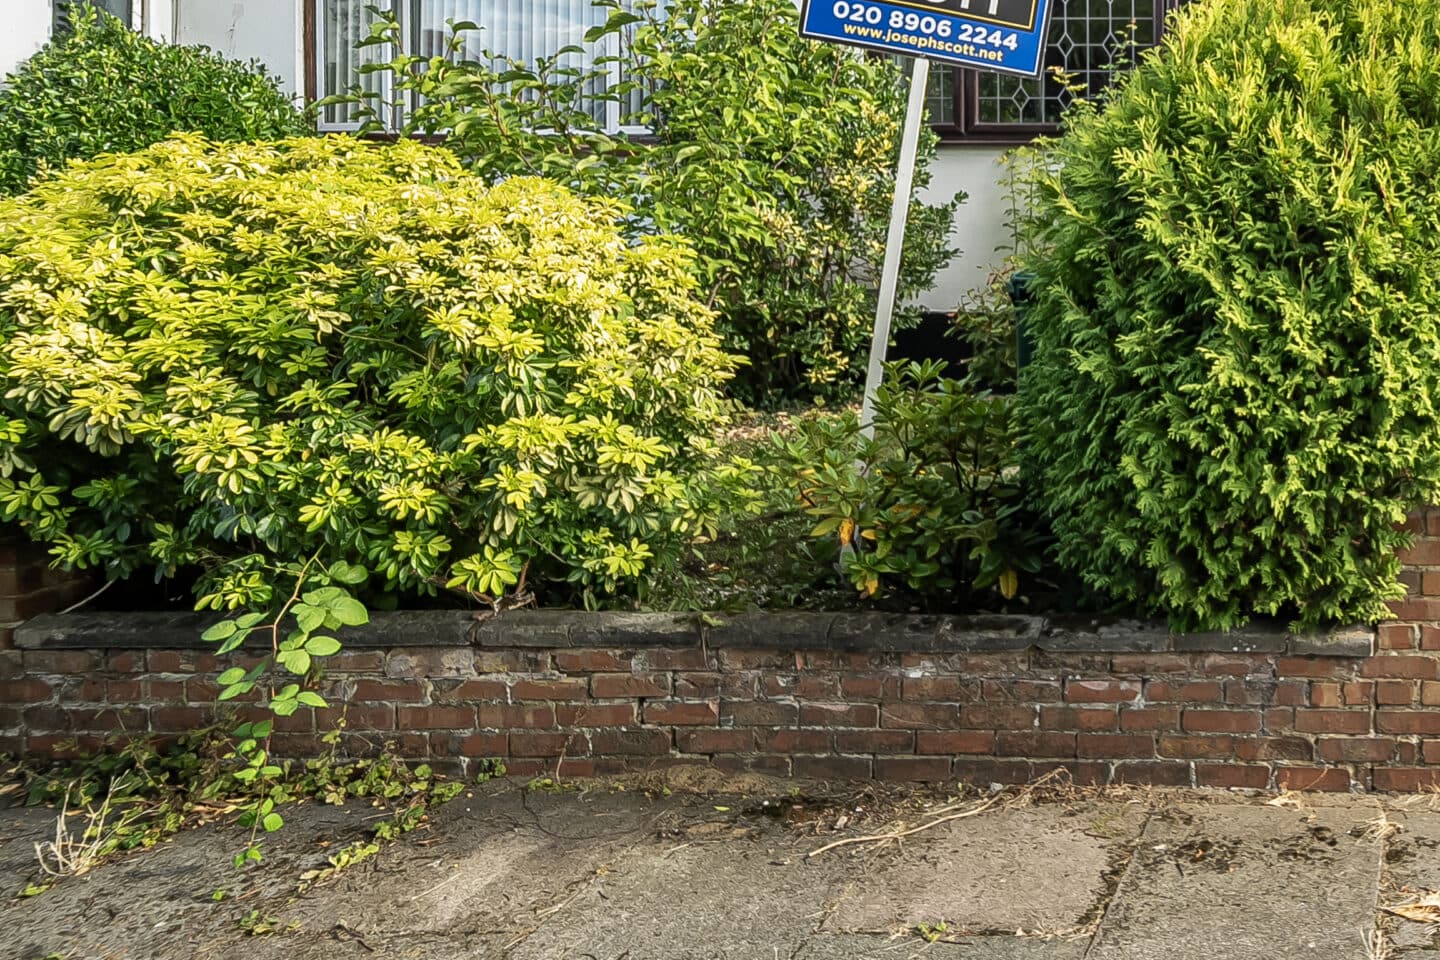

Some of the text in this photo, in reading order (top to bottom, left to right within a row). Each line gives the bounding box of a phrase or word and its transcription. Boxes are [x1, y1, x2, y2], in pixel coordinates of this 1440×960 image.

[832, 1, 1018, 50] 020 8906 2244
[843, 23, 1003, 61] www.josephscott.net
